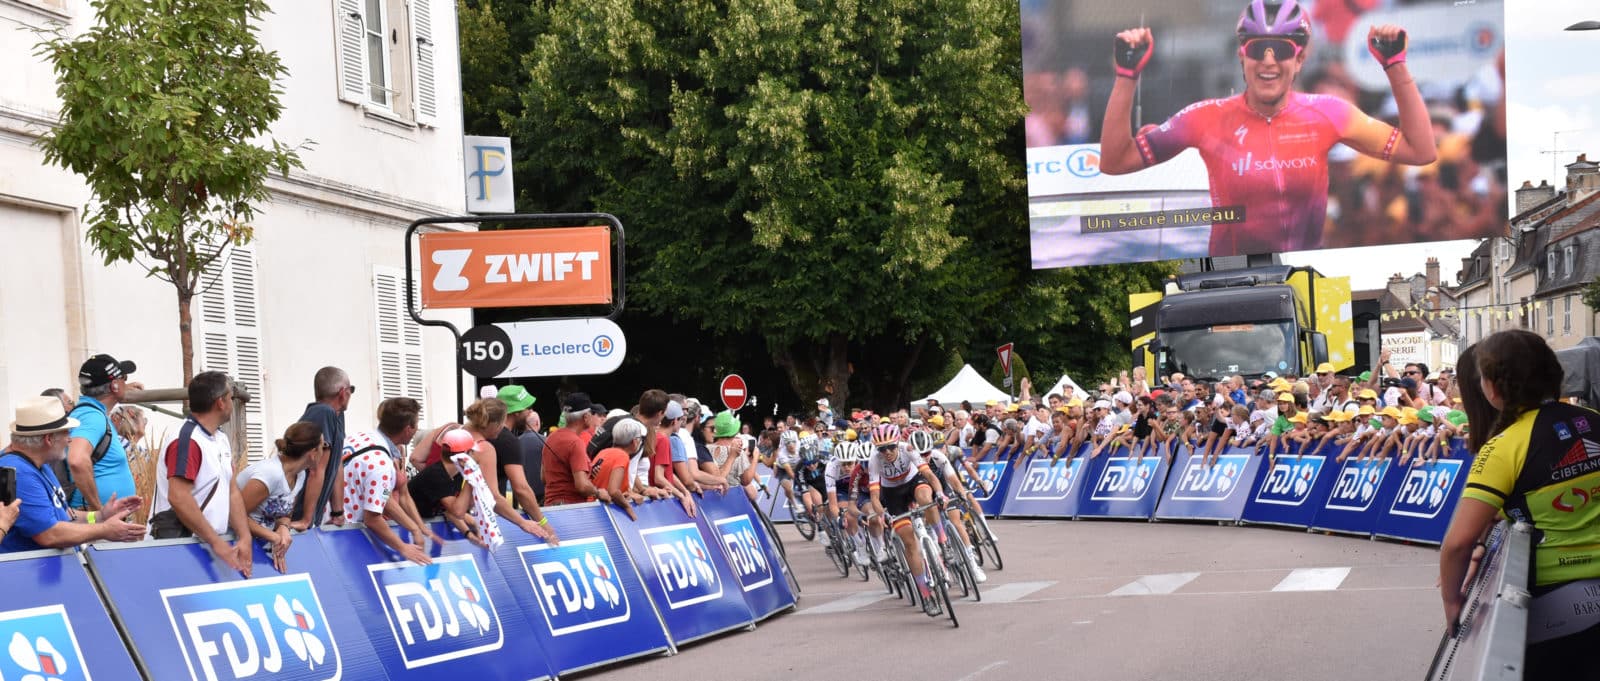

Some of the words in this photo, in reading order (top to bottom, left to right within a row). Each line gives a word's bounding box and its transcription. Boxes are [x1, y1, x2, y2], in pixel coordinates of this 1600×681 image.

[1087, 216, 1111, 230] Un
[1118, 211, 1166, 229] sacré
[1173, 208, 1240, 225] niveau.
[484, 251, 599, 284] ZWIFT
[462, 340, 505, 361] 150
[520, 342, 591, 356] E.Leclerc
[1023, 467, 1059, 493] FDJ
[1099, 466, 1134, 493] FDJ
[1179, 464, 1222, 492] FDJ
[1263, 464, 1299, 495] FDJ
[1333, 466, 1369, 499] FDJ
[1399, 469, 1438, 506] FDJ
[651, 539, 698, 592] FDJ
[723, 531, 756, 577] FDJ
[532, 558, 596, 616] FDJ
[384, 578, 460, 645] FDJ
[183, 603, 283, 681] FDJ
